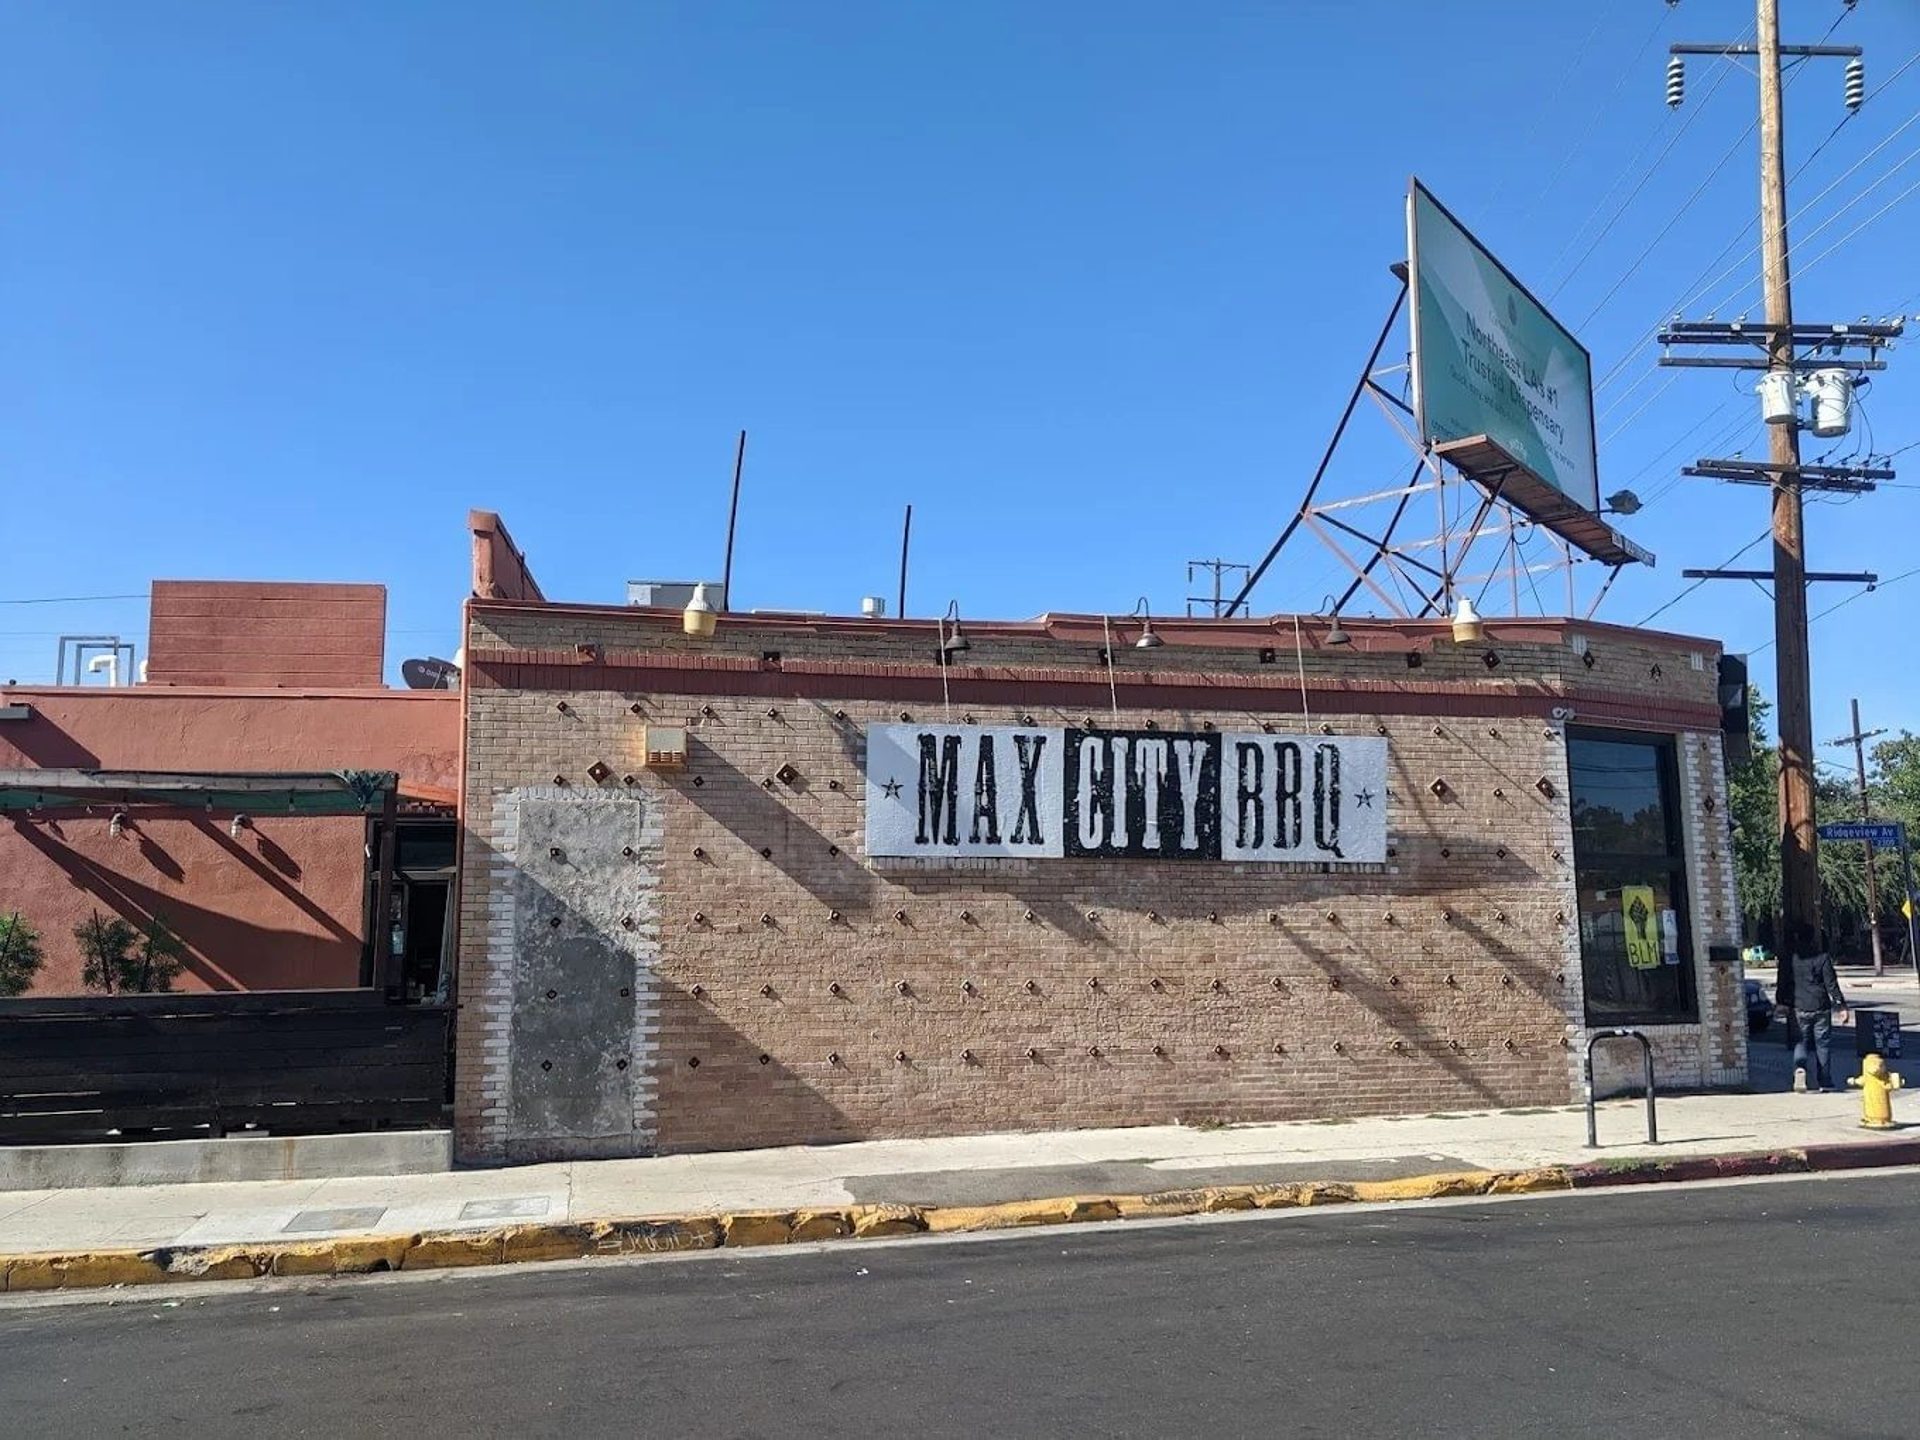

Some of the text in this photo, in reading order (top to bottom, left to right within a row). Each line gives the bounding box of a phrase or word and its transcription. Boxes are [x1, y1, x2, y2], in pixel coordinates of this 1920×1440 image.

[1461, 337, 1504, 393] Trusted
[1510, 378, 1565, 445] Dispensary
[1466, 312, 1520, 378] Northeast
[1547, 383, 1559, 410] #1
[915, 733, 1345, 858] MAX CITY BBQ
[1826, 826, 1894, 838] Ridgeview Av
[1628, 942, 1658, 965] BLM
